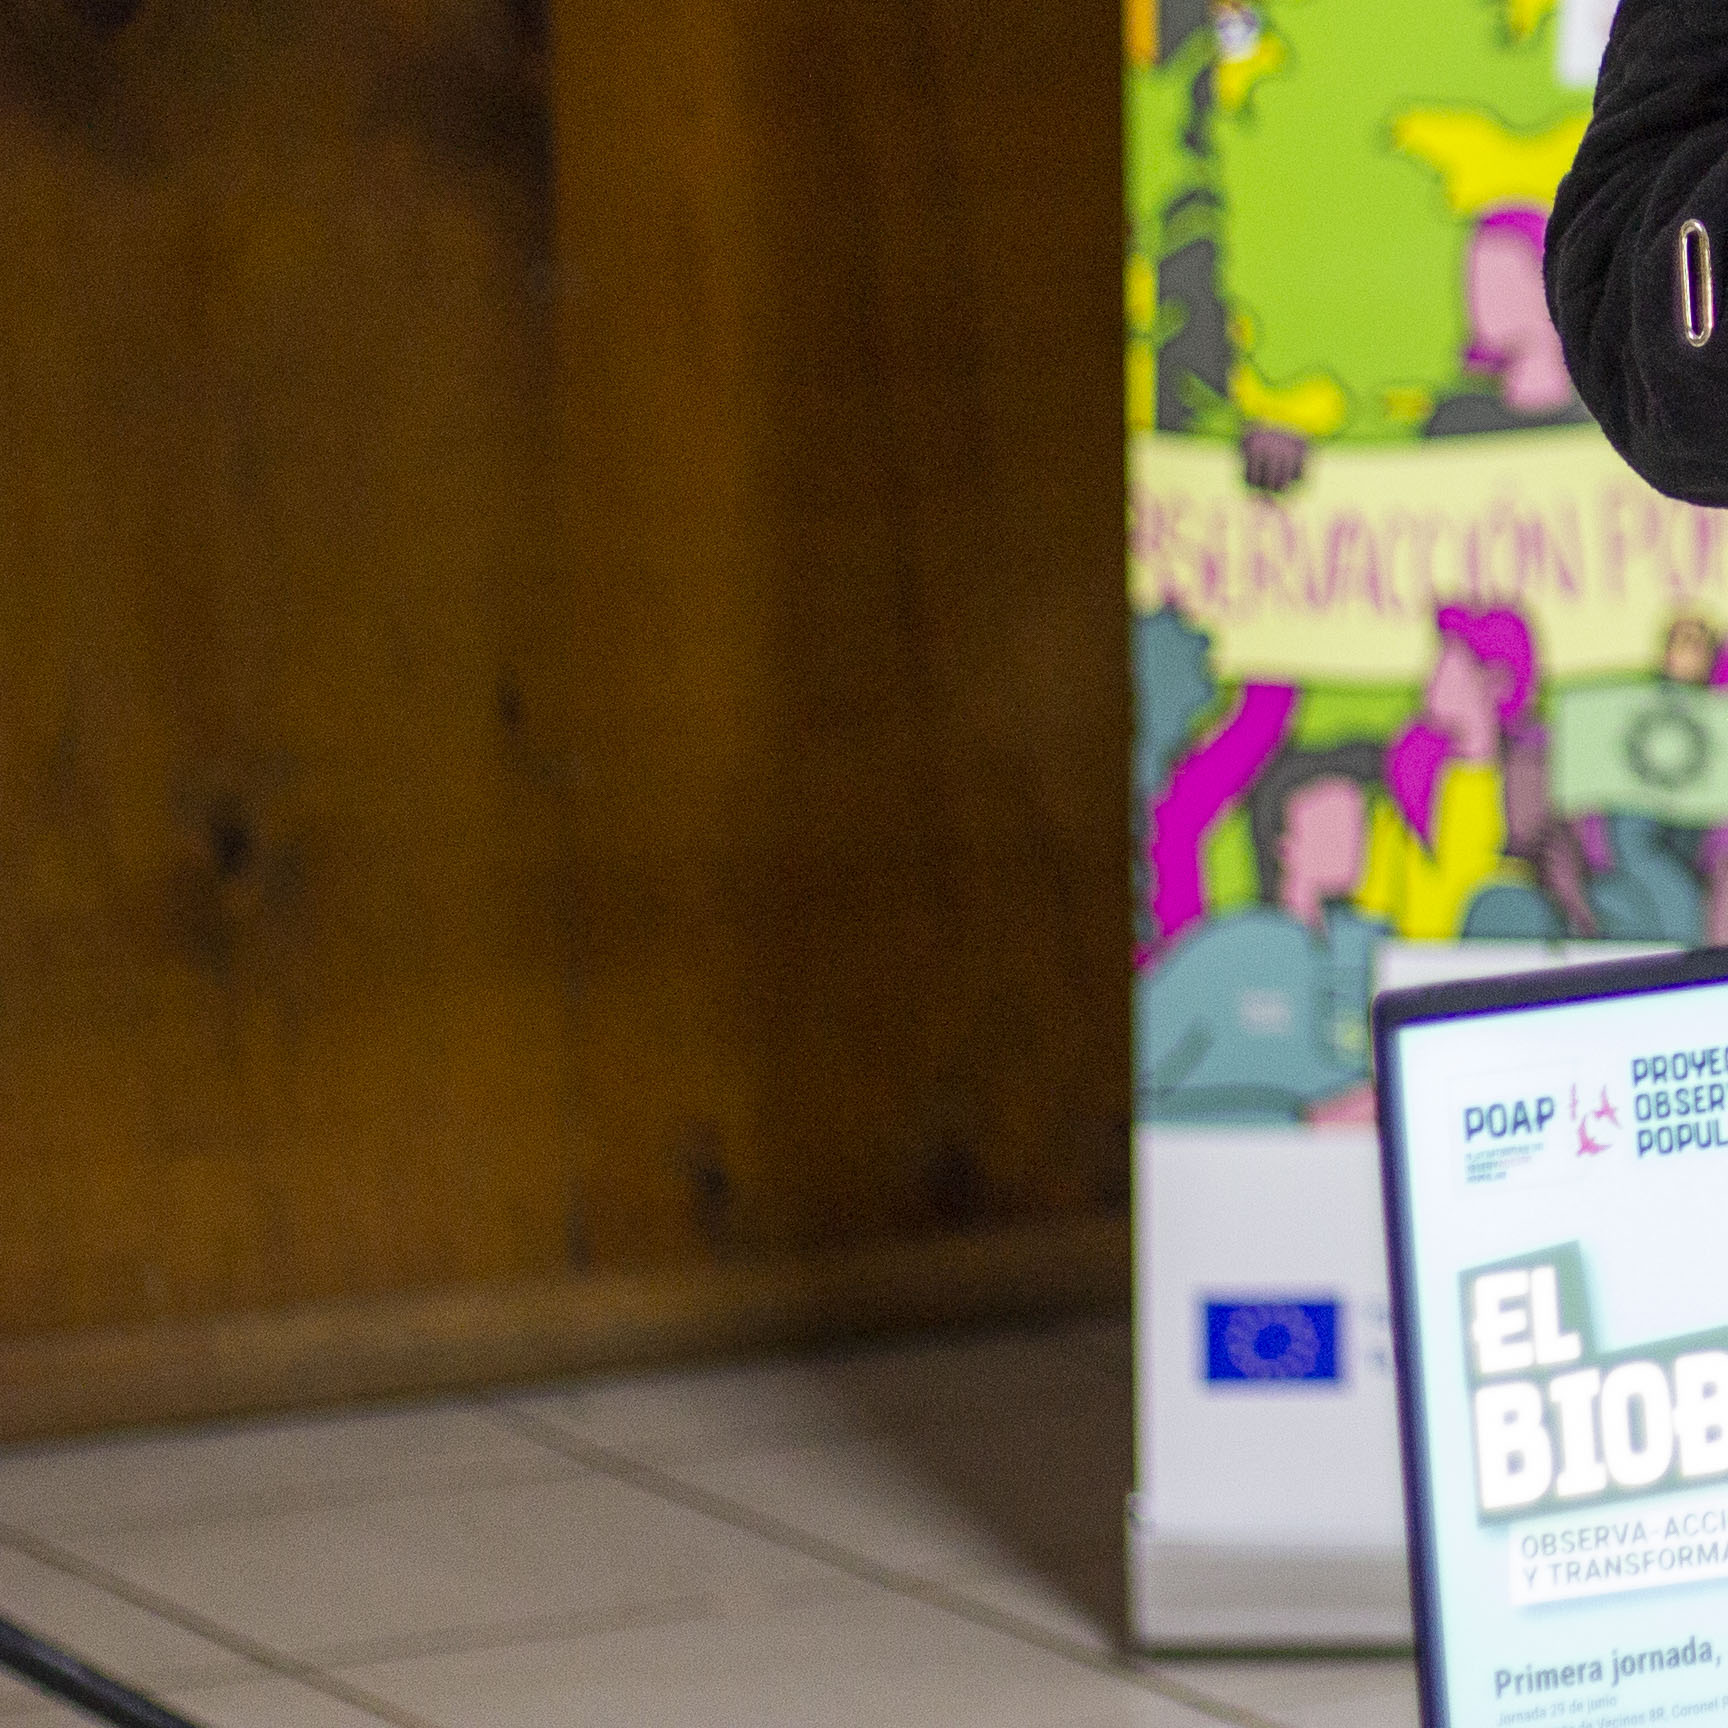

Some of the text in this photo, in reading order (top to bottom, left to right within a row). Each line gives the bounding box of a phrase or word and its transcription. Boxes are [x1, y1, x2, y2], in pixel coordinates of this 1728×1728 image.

[1464, 1096, 1556, 1142] POAP
[1472, 1264, 1582, 1375] EL
[1523, 1565, 1538, 1590] Y
[1494, 1659, 1603, 1699] Primera
[1611, 1635, 1721, 1687] jornada,
